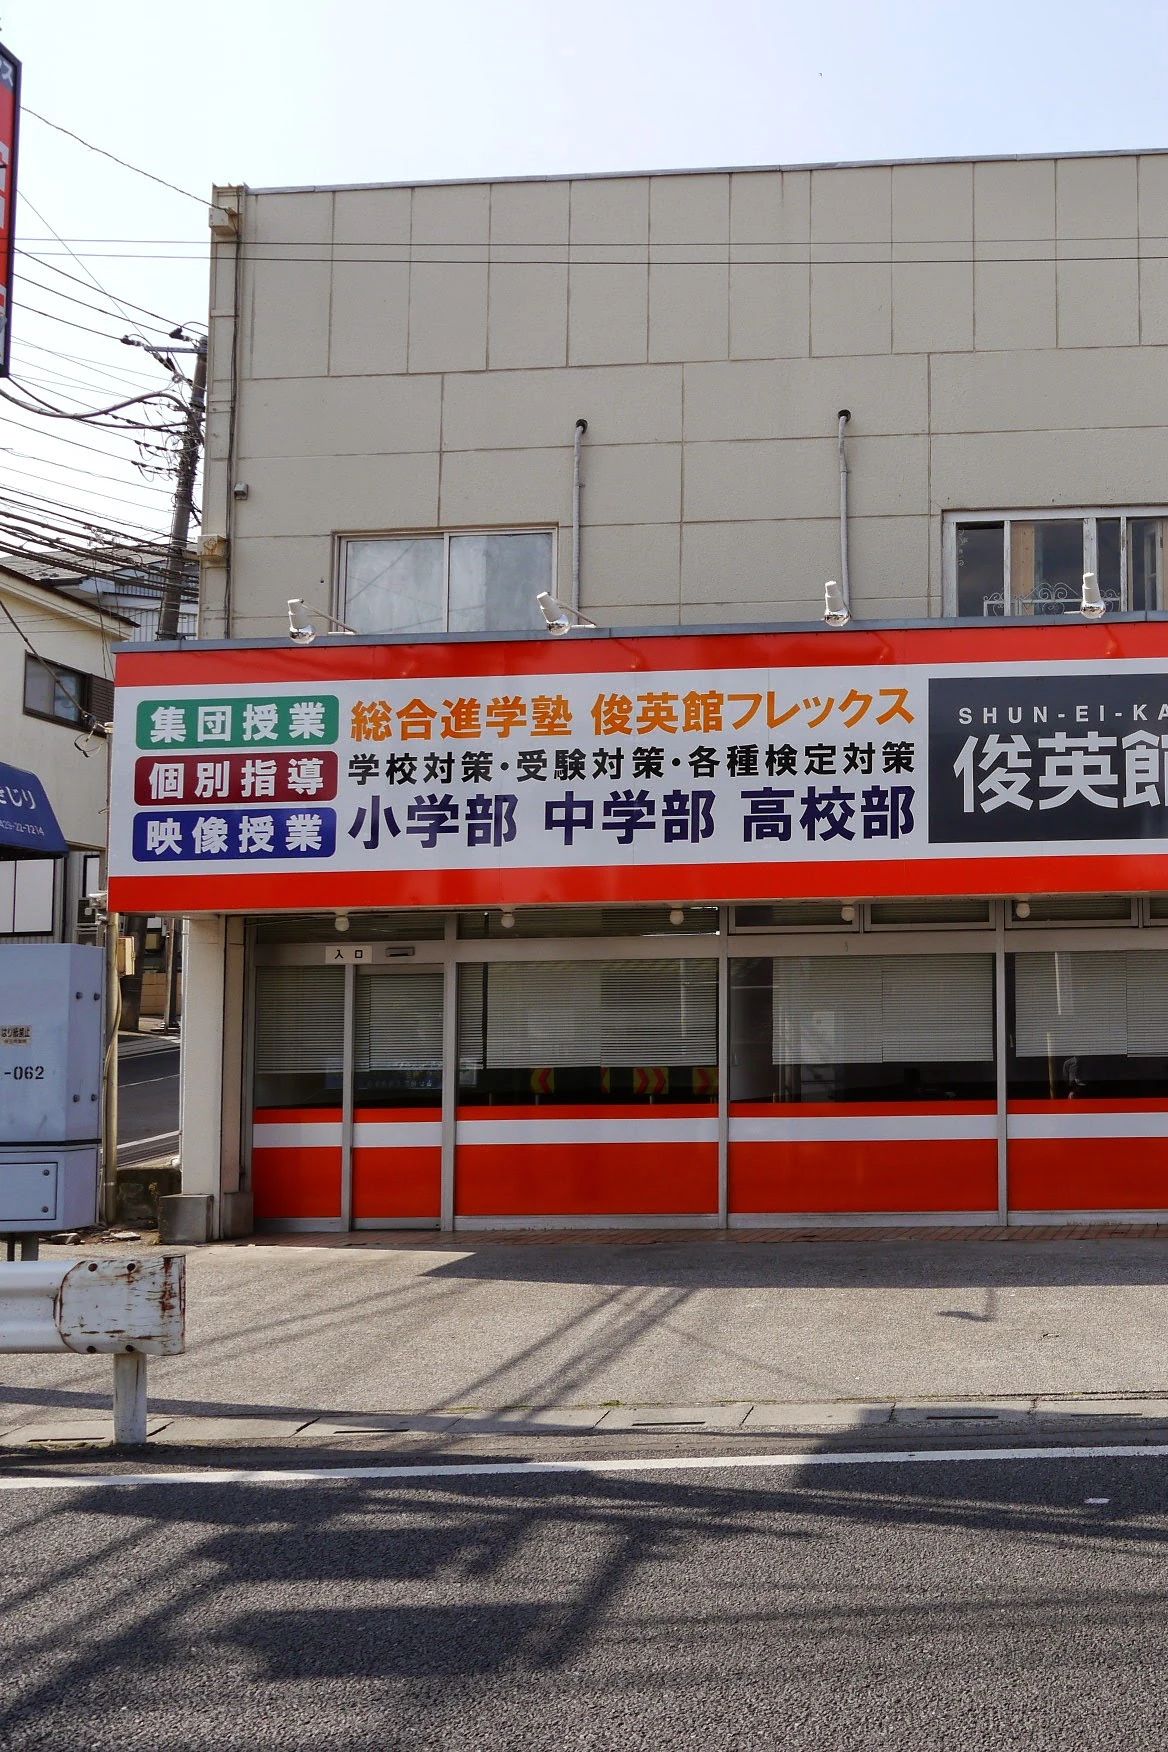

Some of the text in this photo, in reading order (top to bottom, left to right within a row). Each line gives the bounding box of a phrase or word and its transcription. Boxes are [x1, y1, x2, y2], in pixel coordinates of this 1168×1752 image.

[150, 703, 327, 743] 集団授業
[350, 688, 915, 742] 総合進学塾 俊英館フレックス
[149, 757, 325, 799] 個別指導
[347, 741, 915, 785] 学校対策・受験対策・各種検定対策
[147, 814, 323, 856] 映像授業
[348, 785, 915, 850] 小学部 中学部 高校部
[334, 949, 363, 960] 入口
